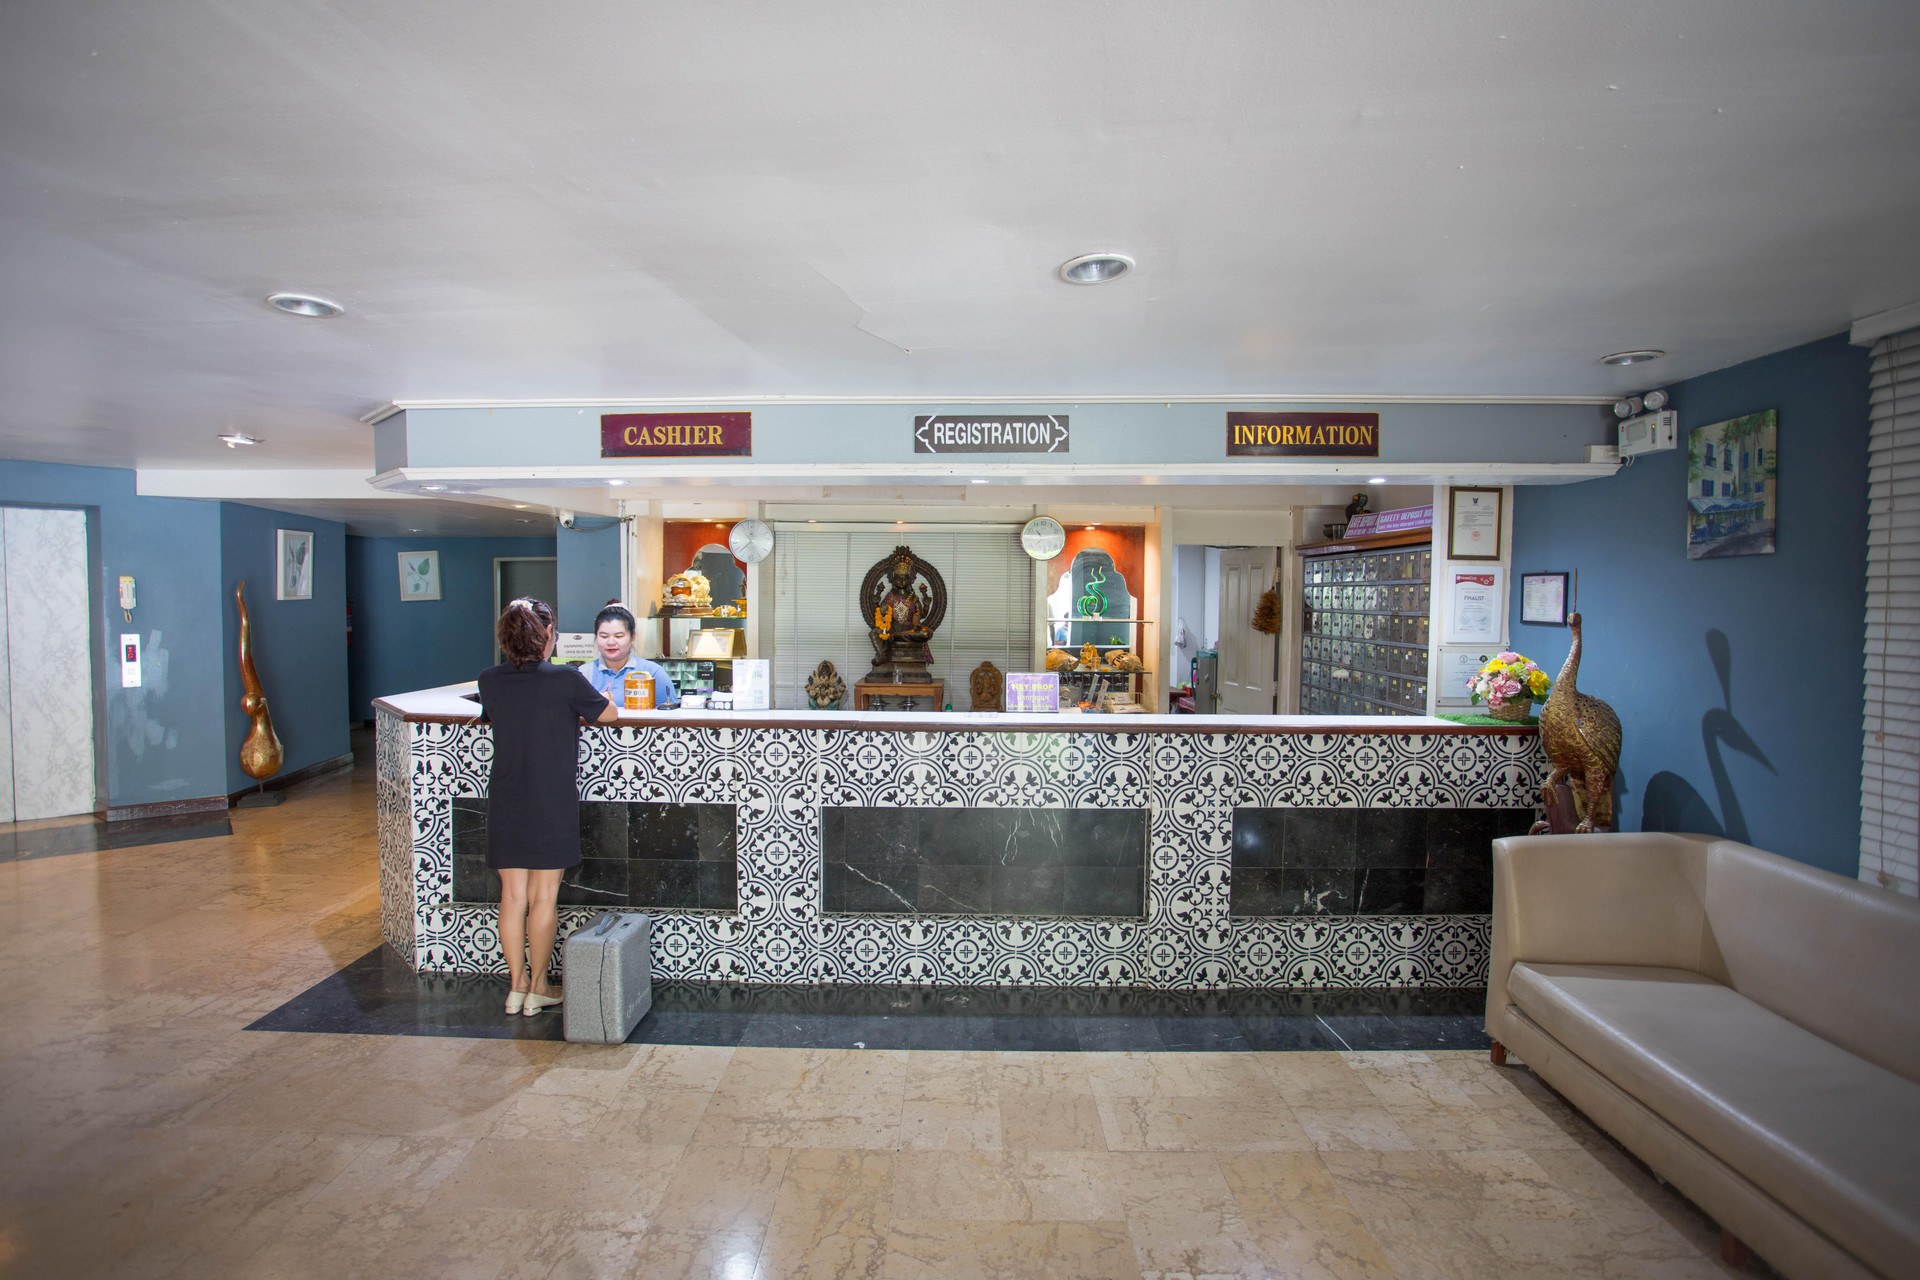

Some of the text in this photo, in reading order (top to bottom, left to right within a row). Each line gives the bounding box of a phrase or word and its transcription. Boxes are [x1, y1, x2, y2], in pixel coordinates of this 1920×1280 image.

[624, 425, 723, 446] CASHIER
[934, 423, 1050, 444] REGISTRATION
[1234, 425, 1373, 445] INFORMATION
[1381, 513, 1399, 523] SAFETY
[1401, 510, 1423, 520] DEPOSIT
